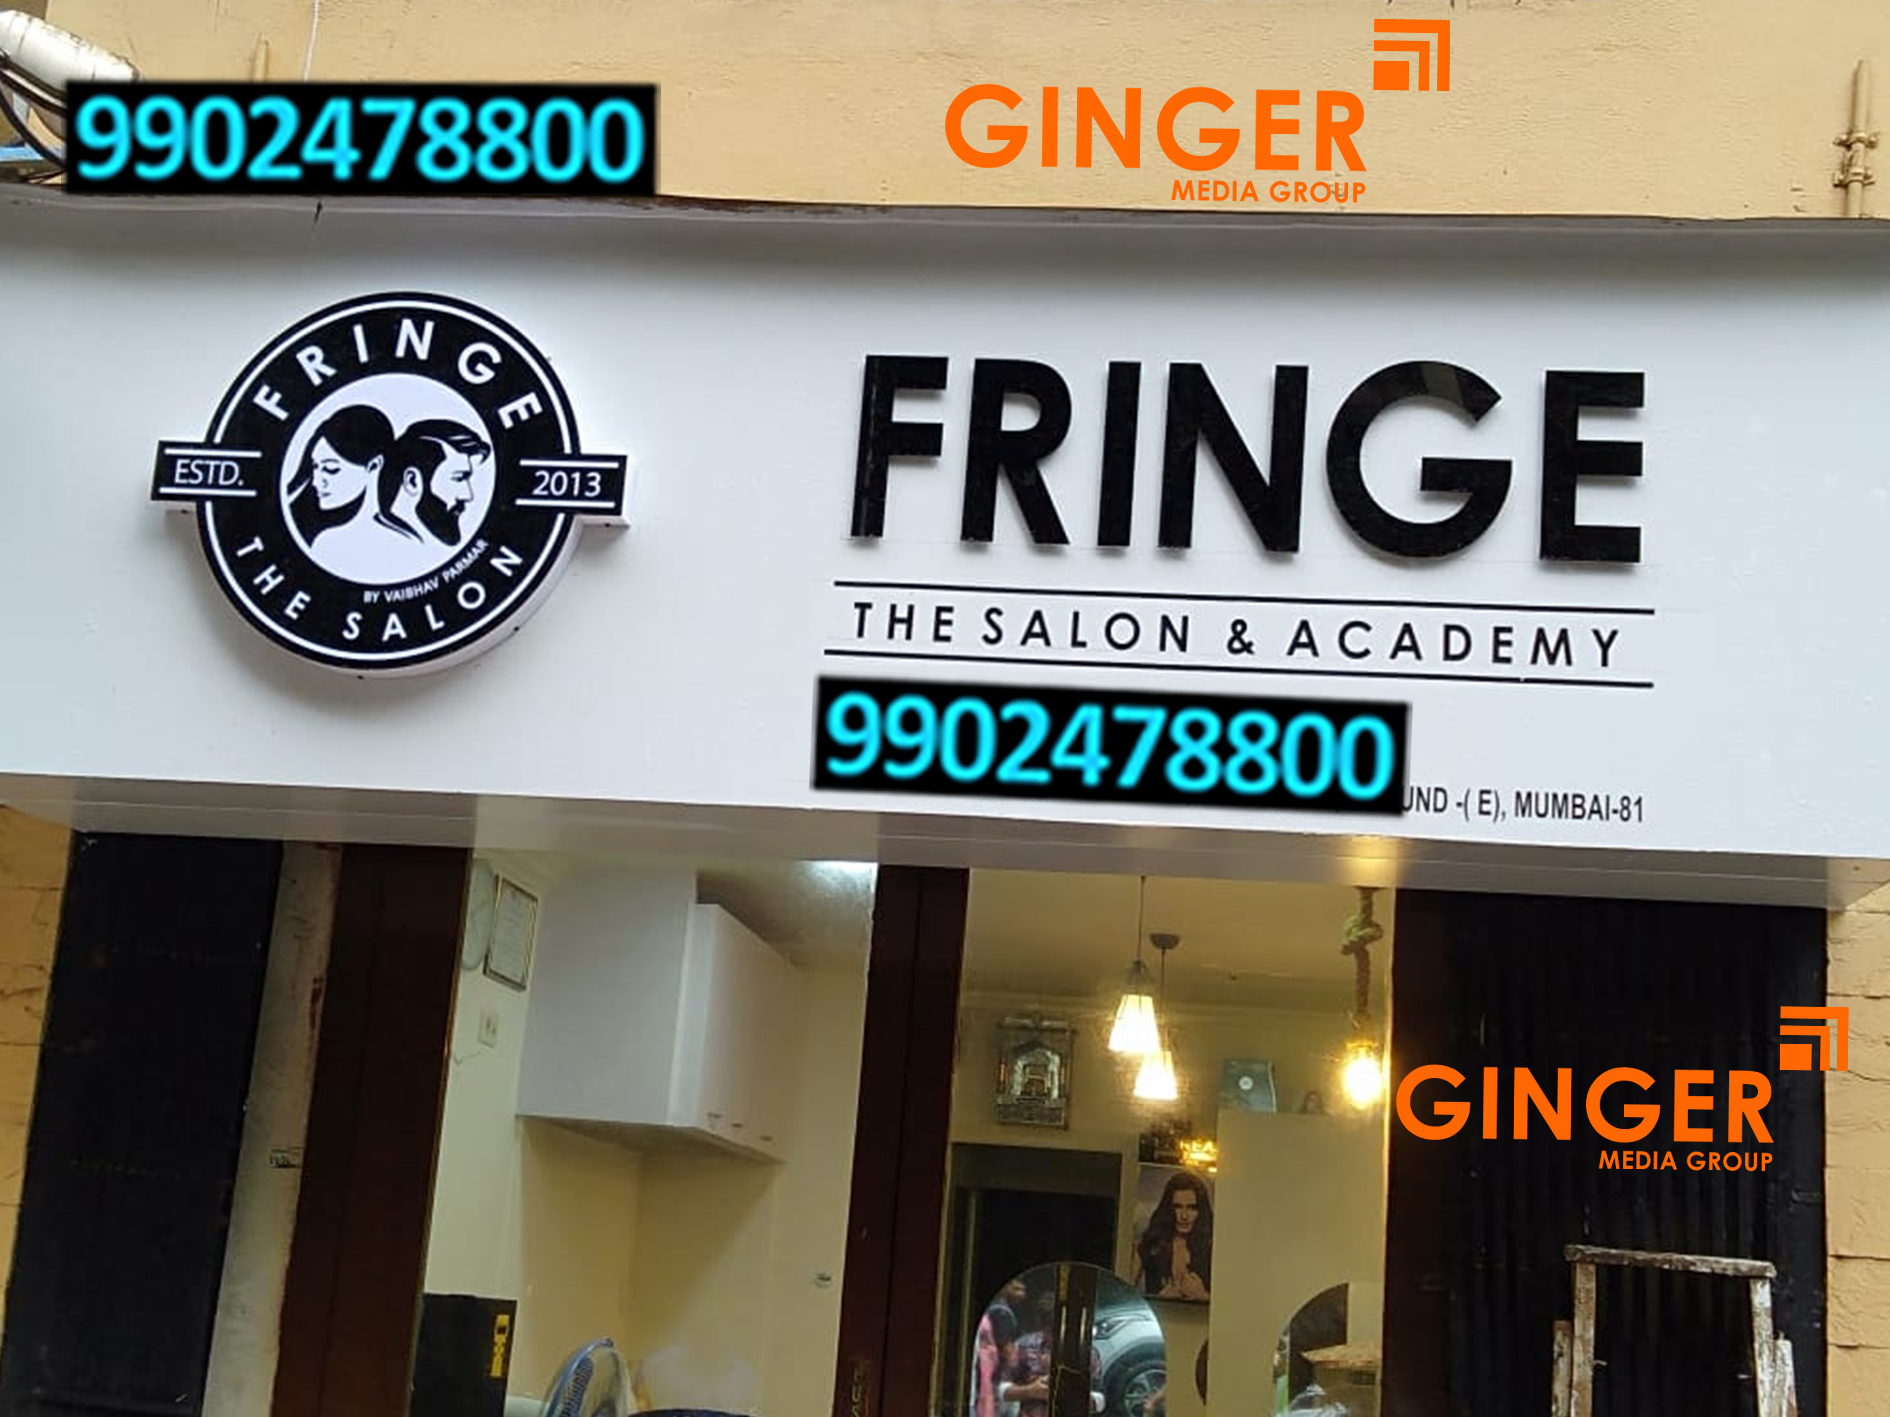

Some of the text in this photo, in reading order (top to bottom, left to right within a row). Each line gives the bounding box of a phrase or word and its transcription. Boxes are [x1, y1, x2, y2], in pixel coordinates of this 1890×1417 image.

[253, 318, 544, 429] FRINGE
[174, 458, 244, 487] ESTD.
[532, 470, 602, 498] 2013
[850, 355, 1646, 564] FRINGE
[236, 536, 524, 642] THE SALON
[363, 538, 489, 604] BY VAIBHAV PARMAR
[853, 601, 1619, 669] THE SALON & ACADEMY
[1515, 790, 1643, 823] MUMBAI-81
